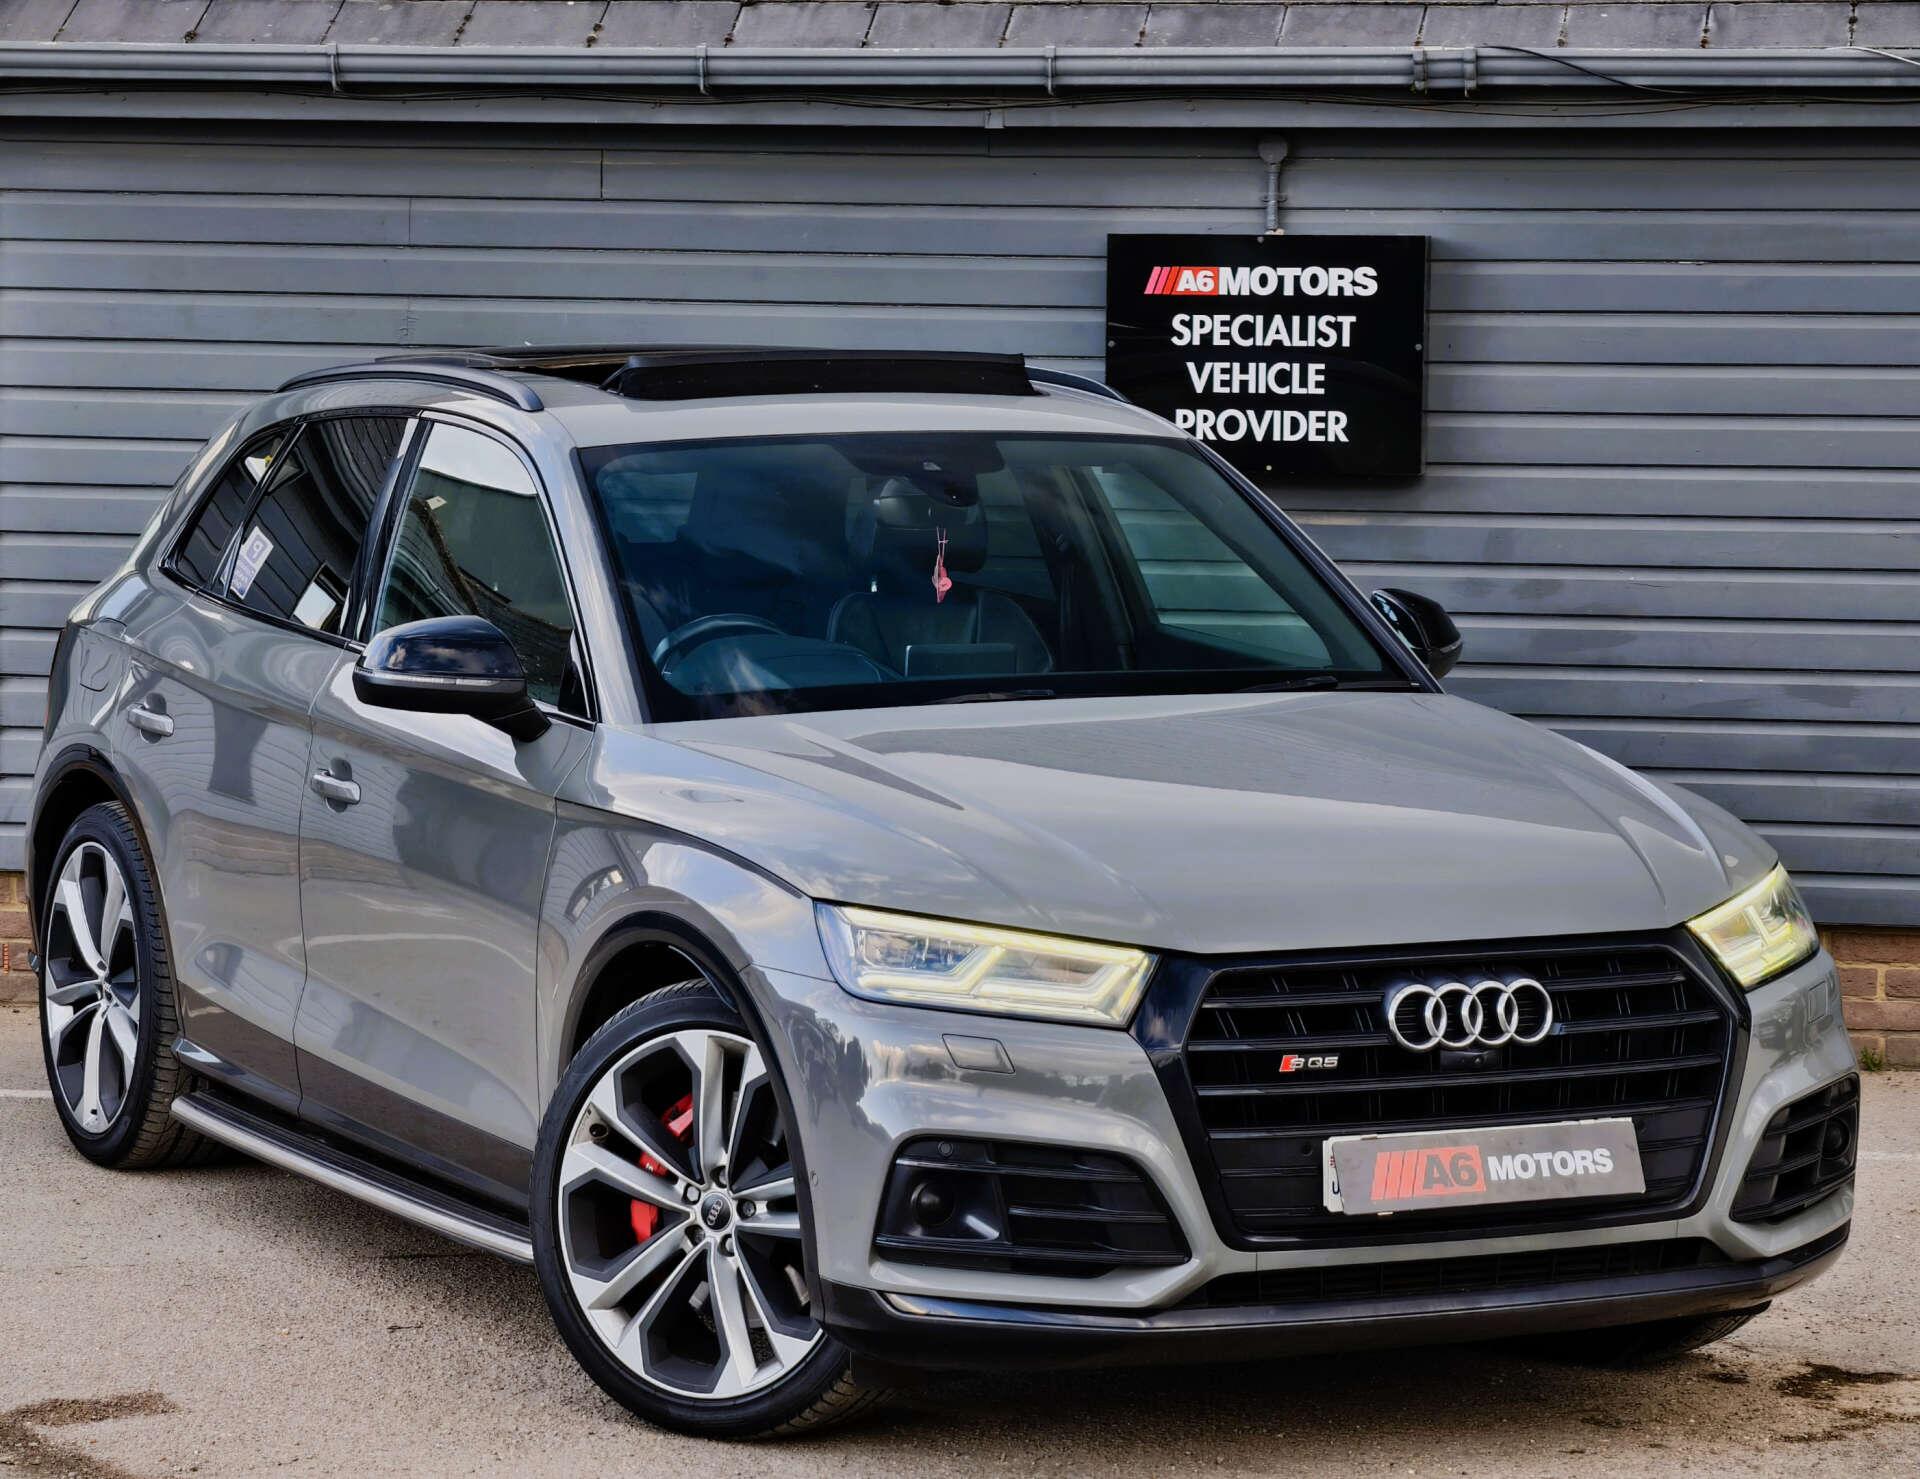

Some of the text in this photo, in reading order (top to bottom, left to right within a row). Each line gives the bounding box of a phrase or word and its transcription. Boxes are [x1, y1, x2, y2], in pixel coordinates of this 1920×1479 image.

[1176, 266, 1378, 297] A6 MOTORS
[1170, 313, 1357, 348] SPECIALIST
[1186, 361, 1326, 395] VEHICLE
[1174, 408, 1350, 443] PROVIDER
[1423, 1147, 1614, 1190] A6 MOTORS
